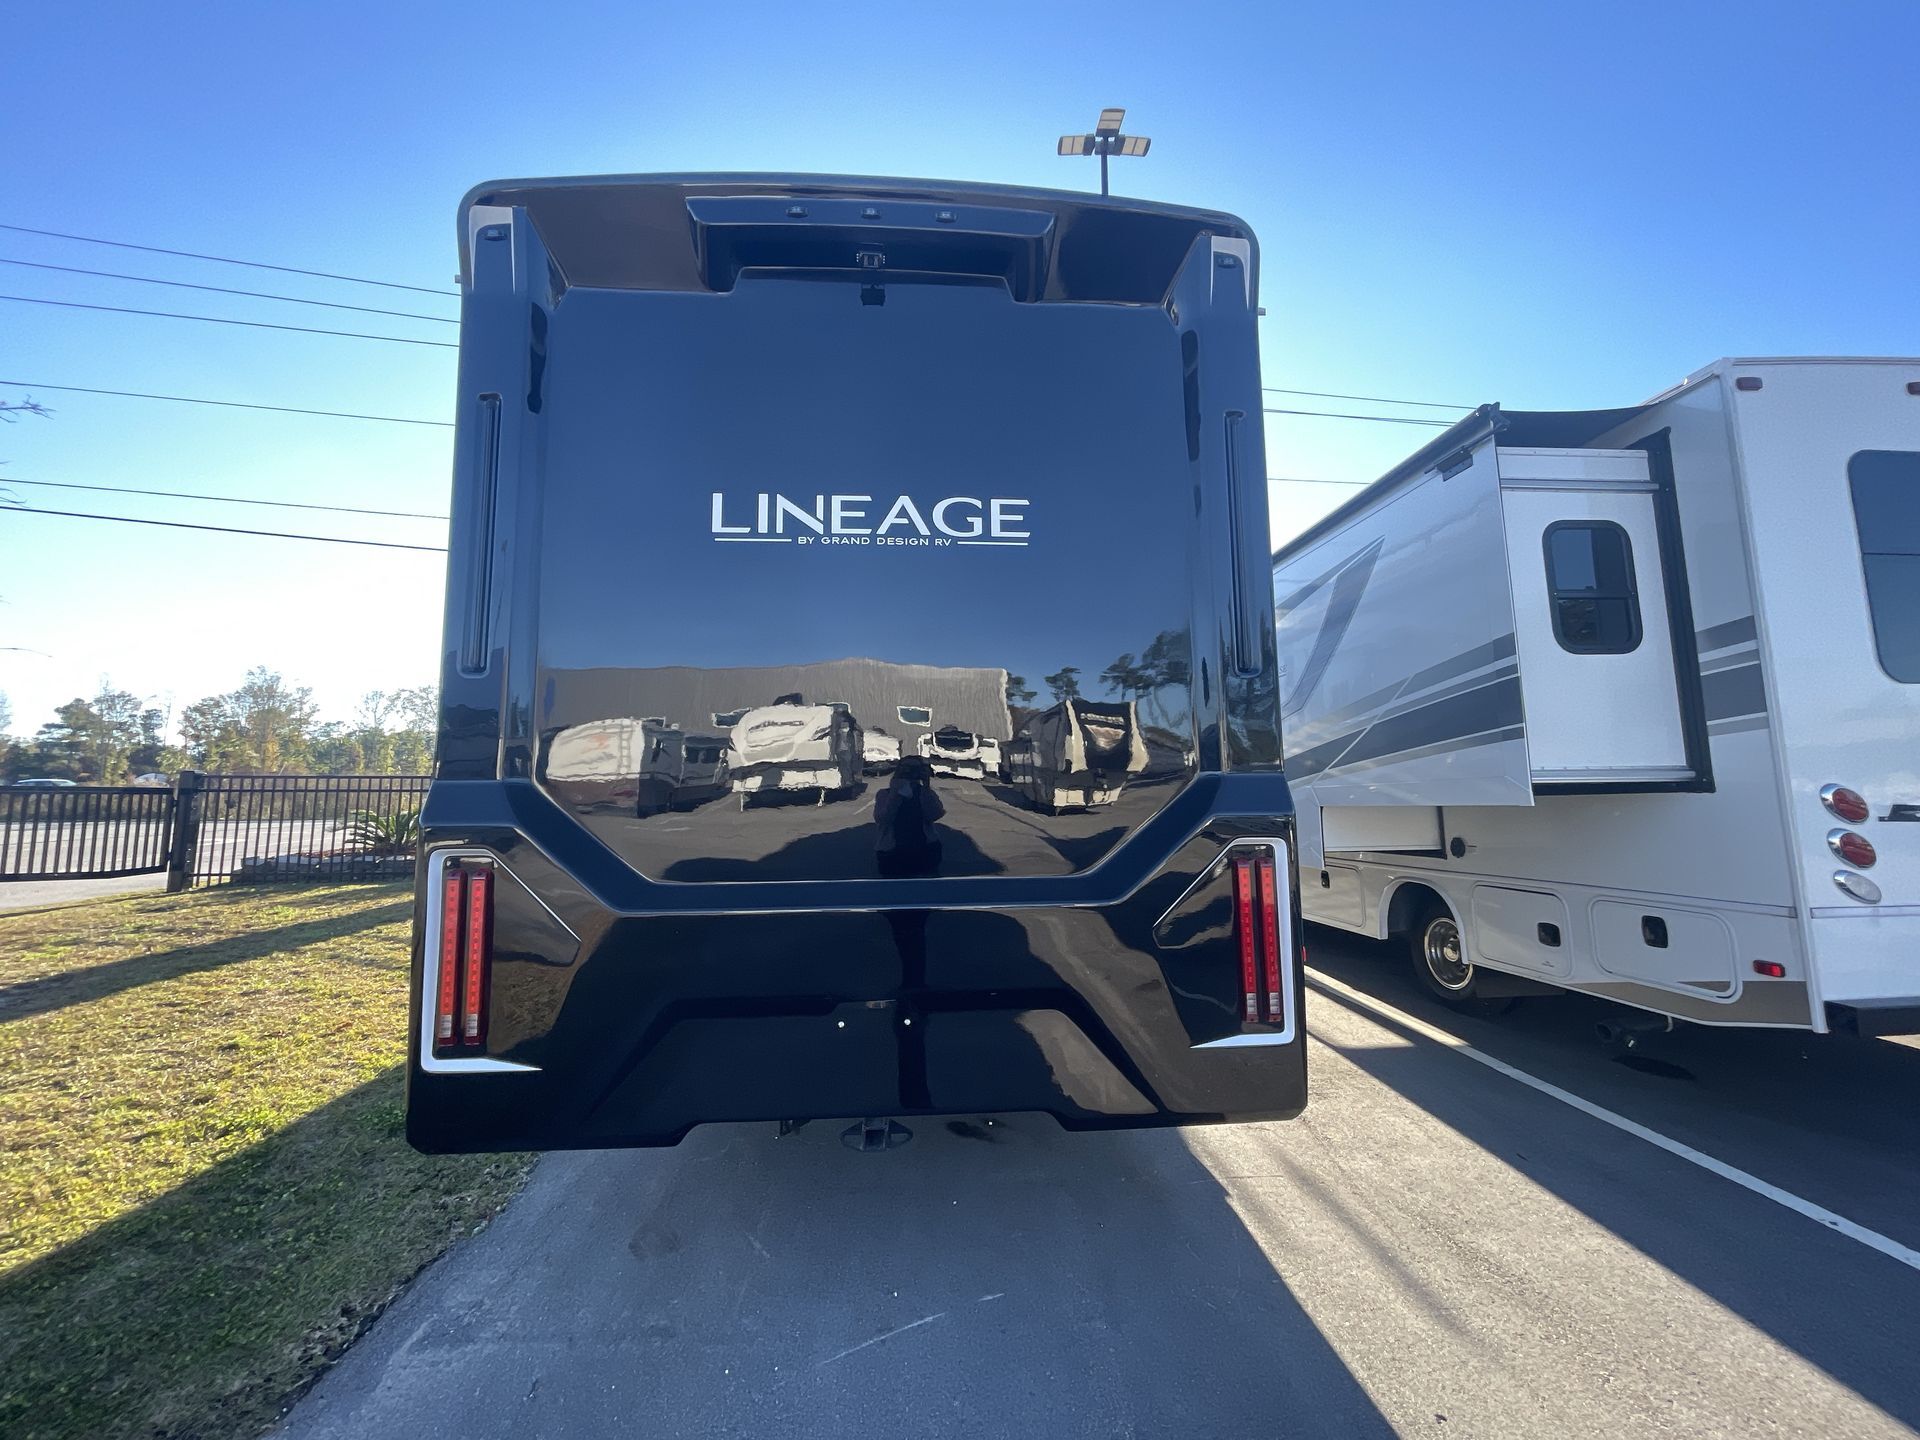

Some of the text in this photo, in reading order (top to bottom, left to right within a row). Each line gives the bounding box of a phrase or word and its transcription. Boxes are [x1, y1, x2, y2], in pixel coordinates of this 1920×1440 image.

[711, 492, 1031, 538] LINEAGE
[797, 536, 952, 546] BY GRAND DESIGN RV
